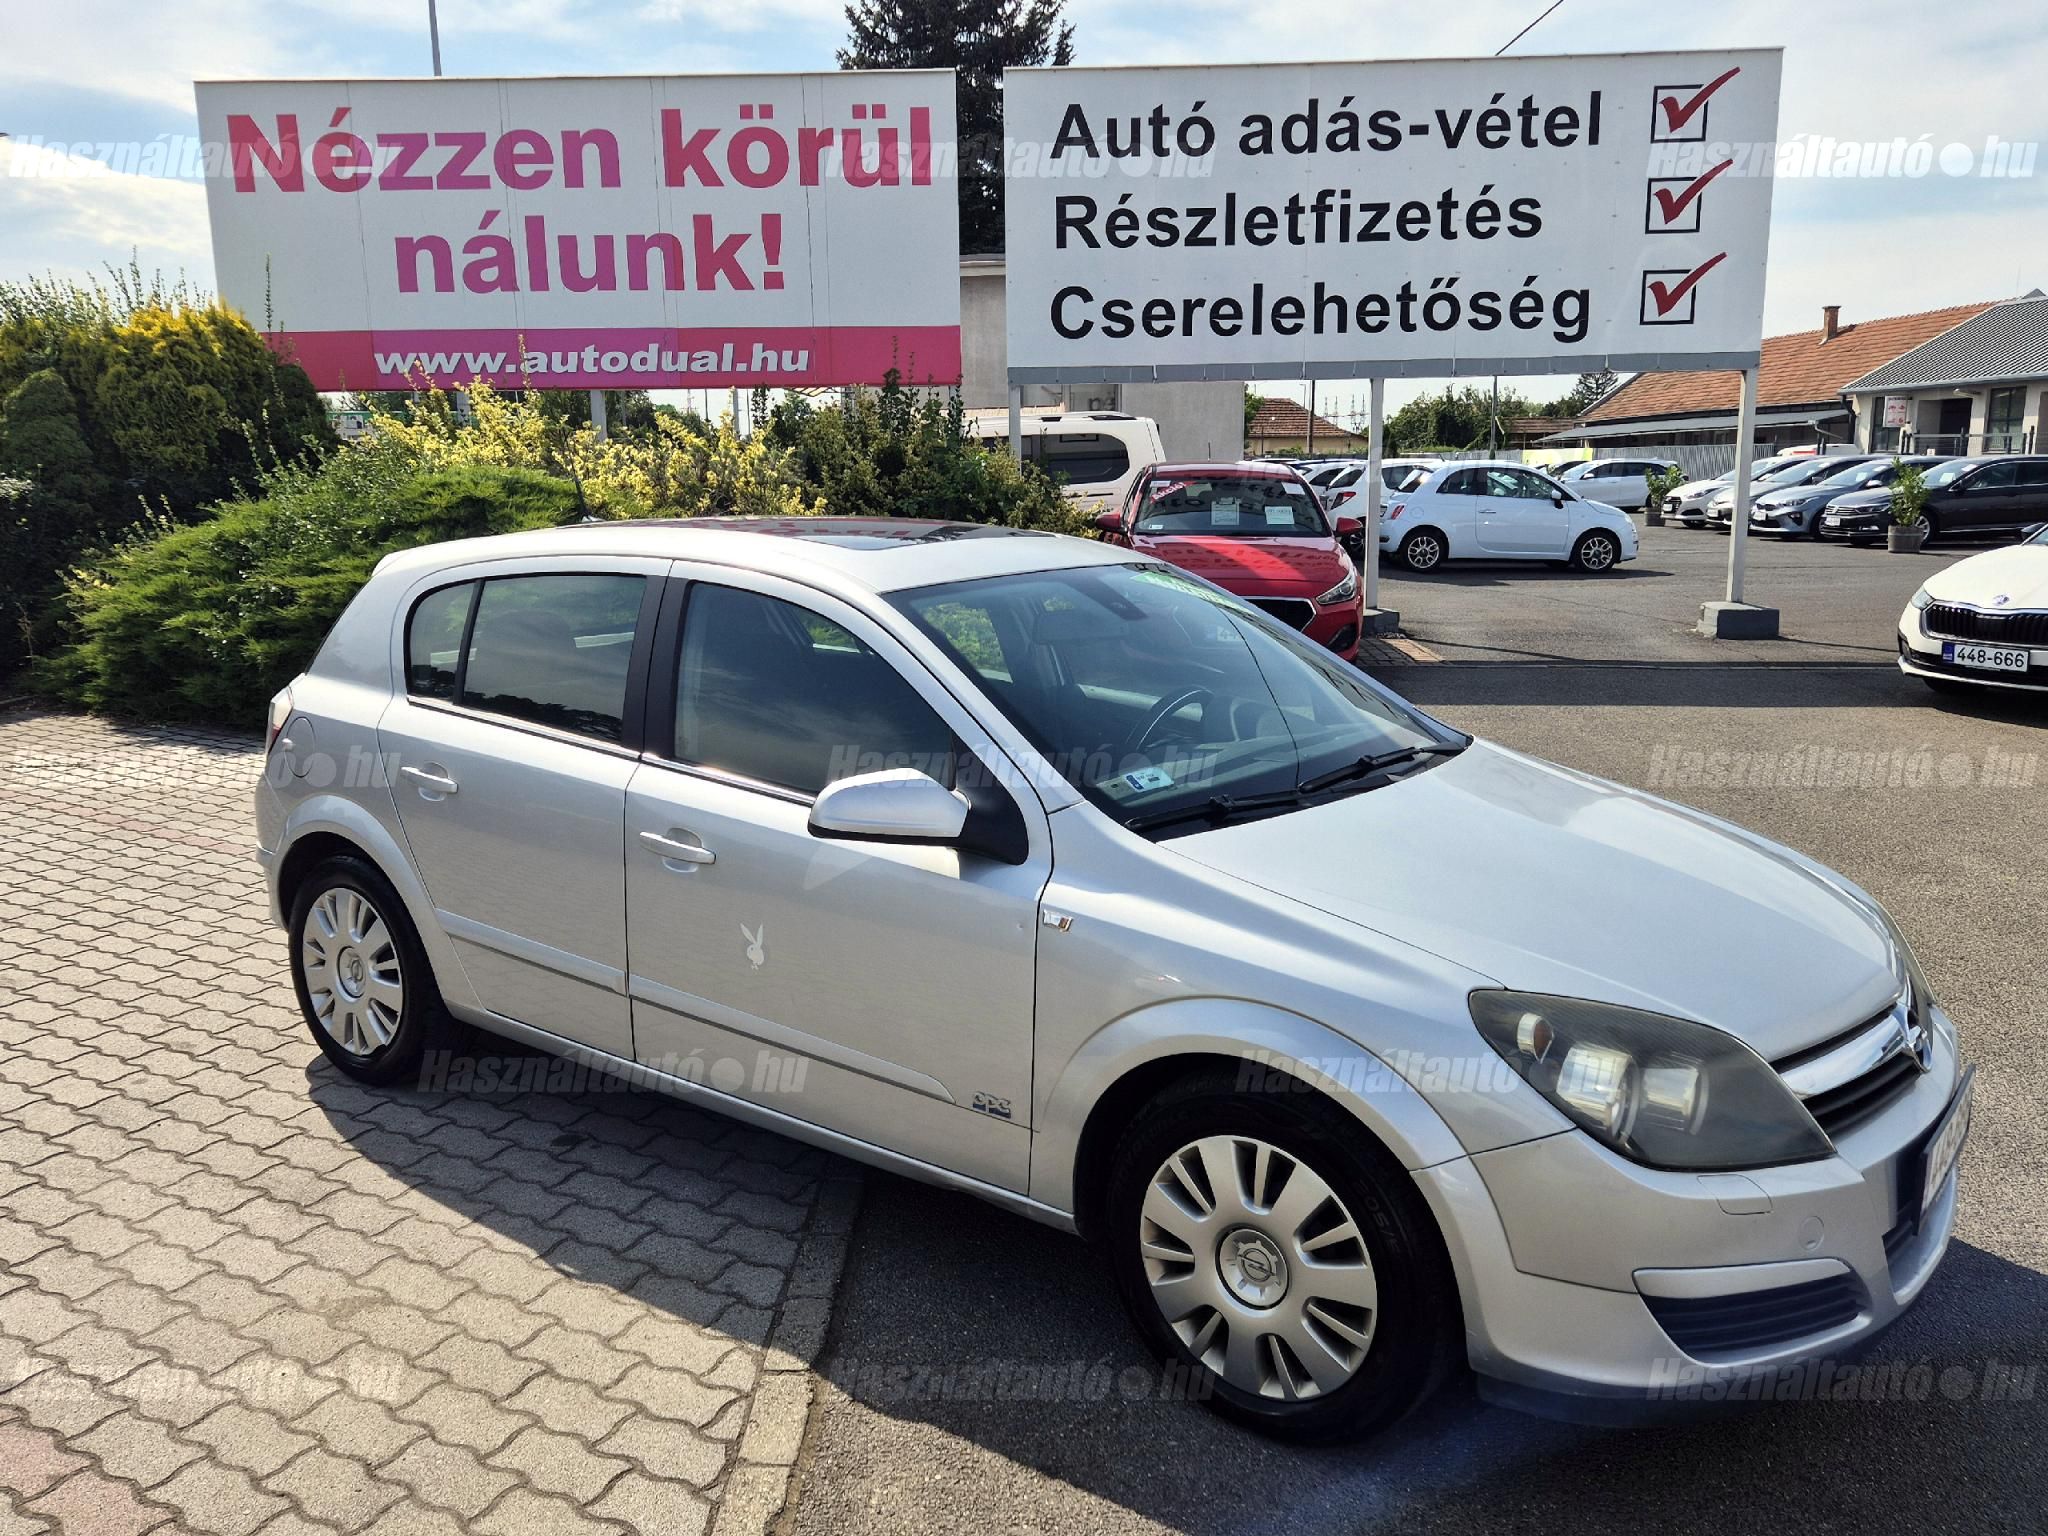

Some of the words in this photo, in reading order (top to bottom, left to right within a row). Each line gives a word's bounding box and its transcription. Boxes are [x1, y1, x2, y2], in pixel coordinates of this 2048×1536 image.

[230, 108, 619, 193] Nézzen
[663, 104, 932, 190] körül
[1051, 101, 1215, 158] Autó
[1238, 90, 1601, 156] adás-vétel
[1056, 184, 1541, 249] Részletfizetés
[398, 212, 783, 293] nálunk!
[1051, 276, 1590, 344] Cserelehetőség
[376, 343, 810, 378] www.autodual.hu
[1956, 646, 2025, 668] 448-666
